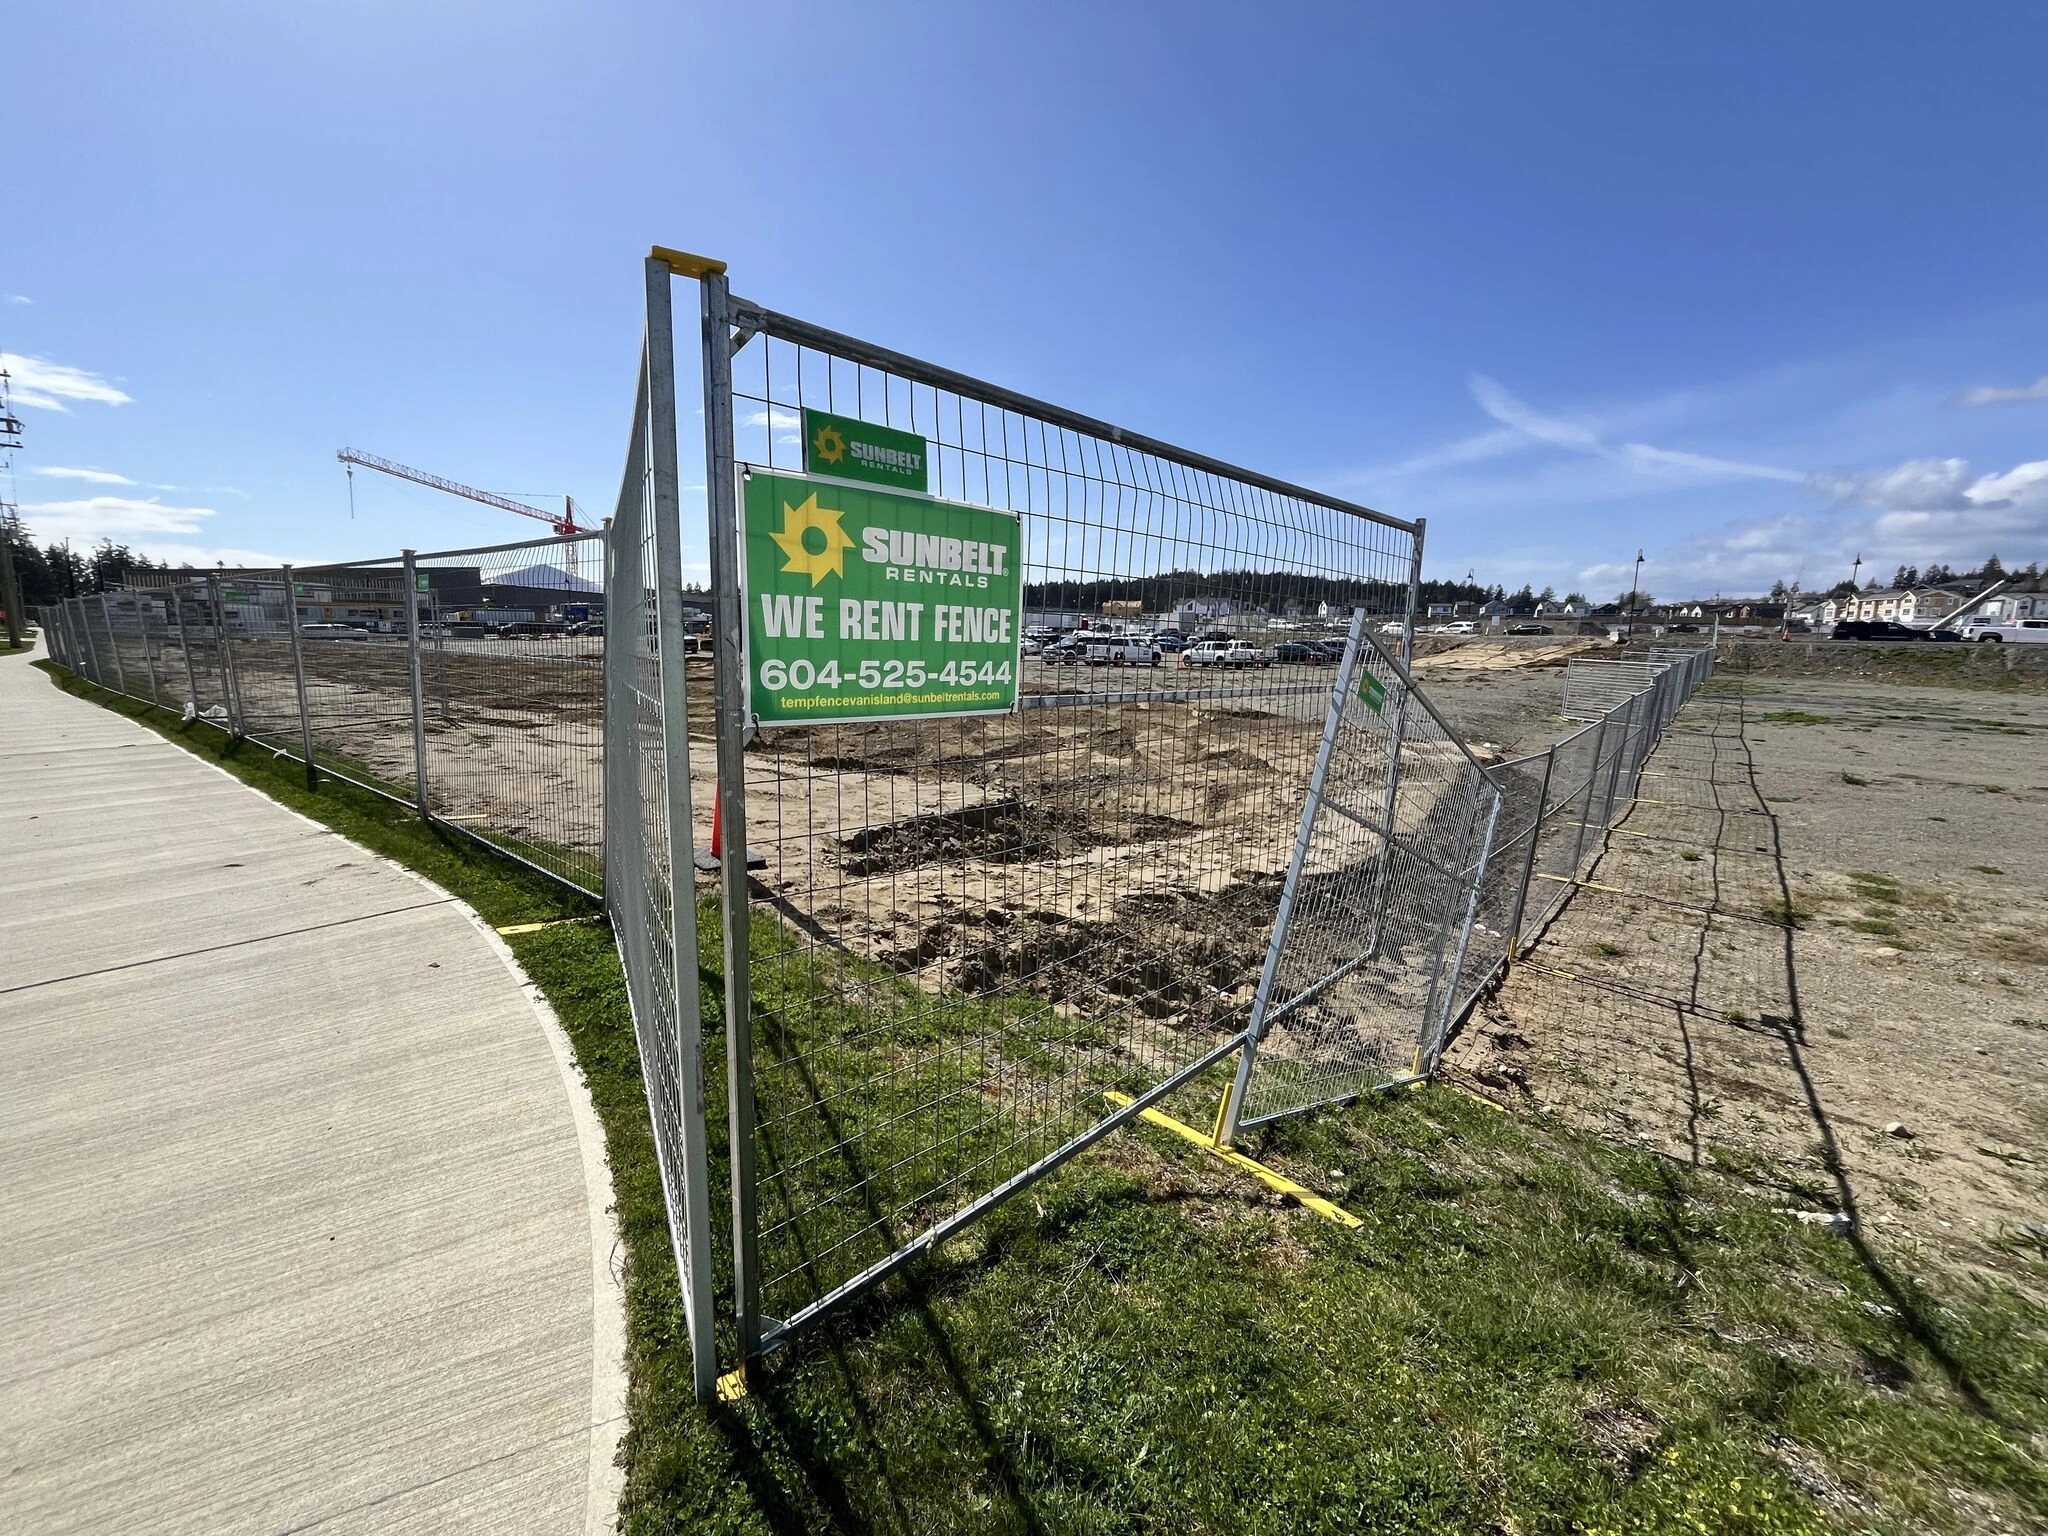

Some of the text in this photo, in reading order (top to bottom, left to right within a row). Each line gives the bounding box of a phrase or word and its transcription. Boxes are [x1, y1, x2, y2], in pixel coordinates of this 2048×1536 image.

[850, 441, 921, 470] SUNBELT
[861, 460, 912, 475] RENTALS
[862, 526, 1007, 577] SUNBELT
[886, 567, 988, 588] RENTALS
[760, 593, 1011, 643] WE RENT FENCE
[760, 659, 1011, 690] 604-525-4544
[781, 691, 1000, 710] tempfencevanisland@sunbeltrentals.com
